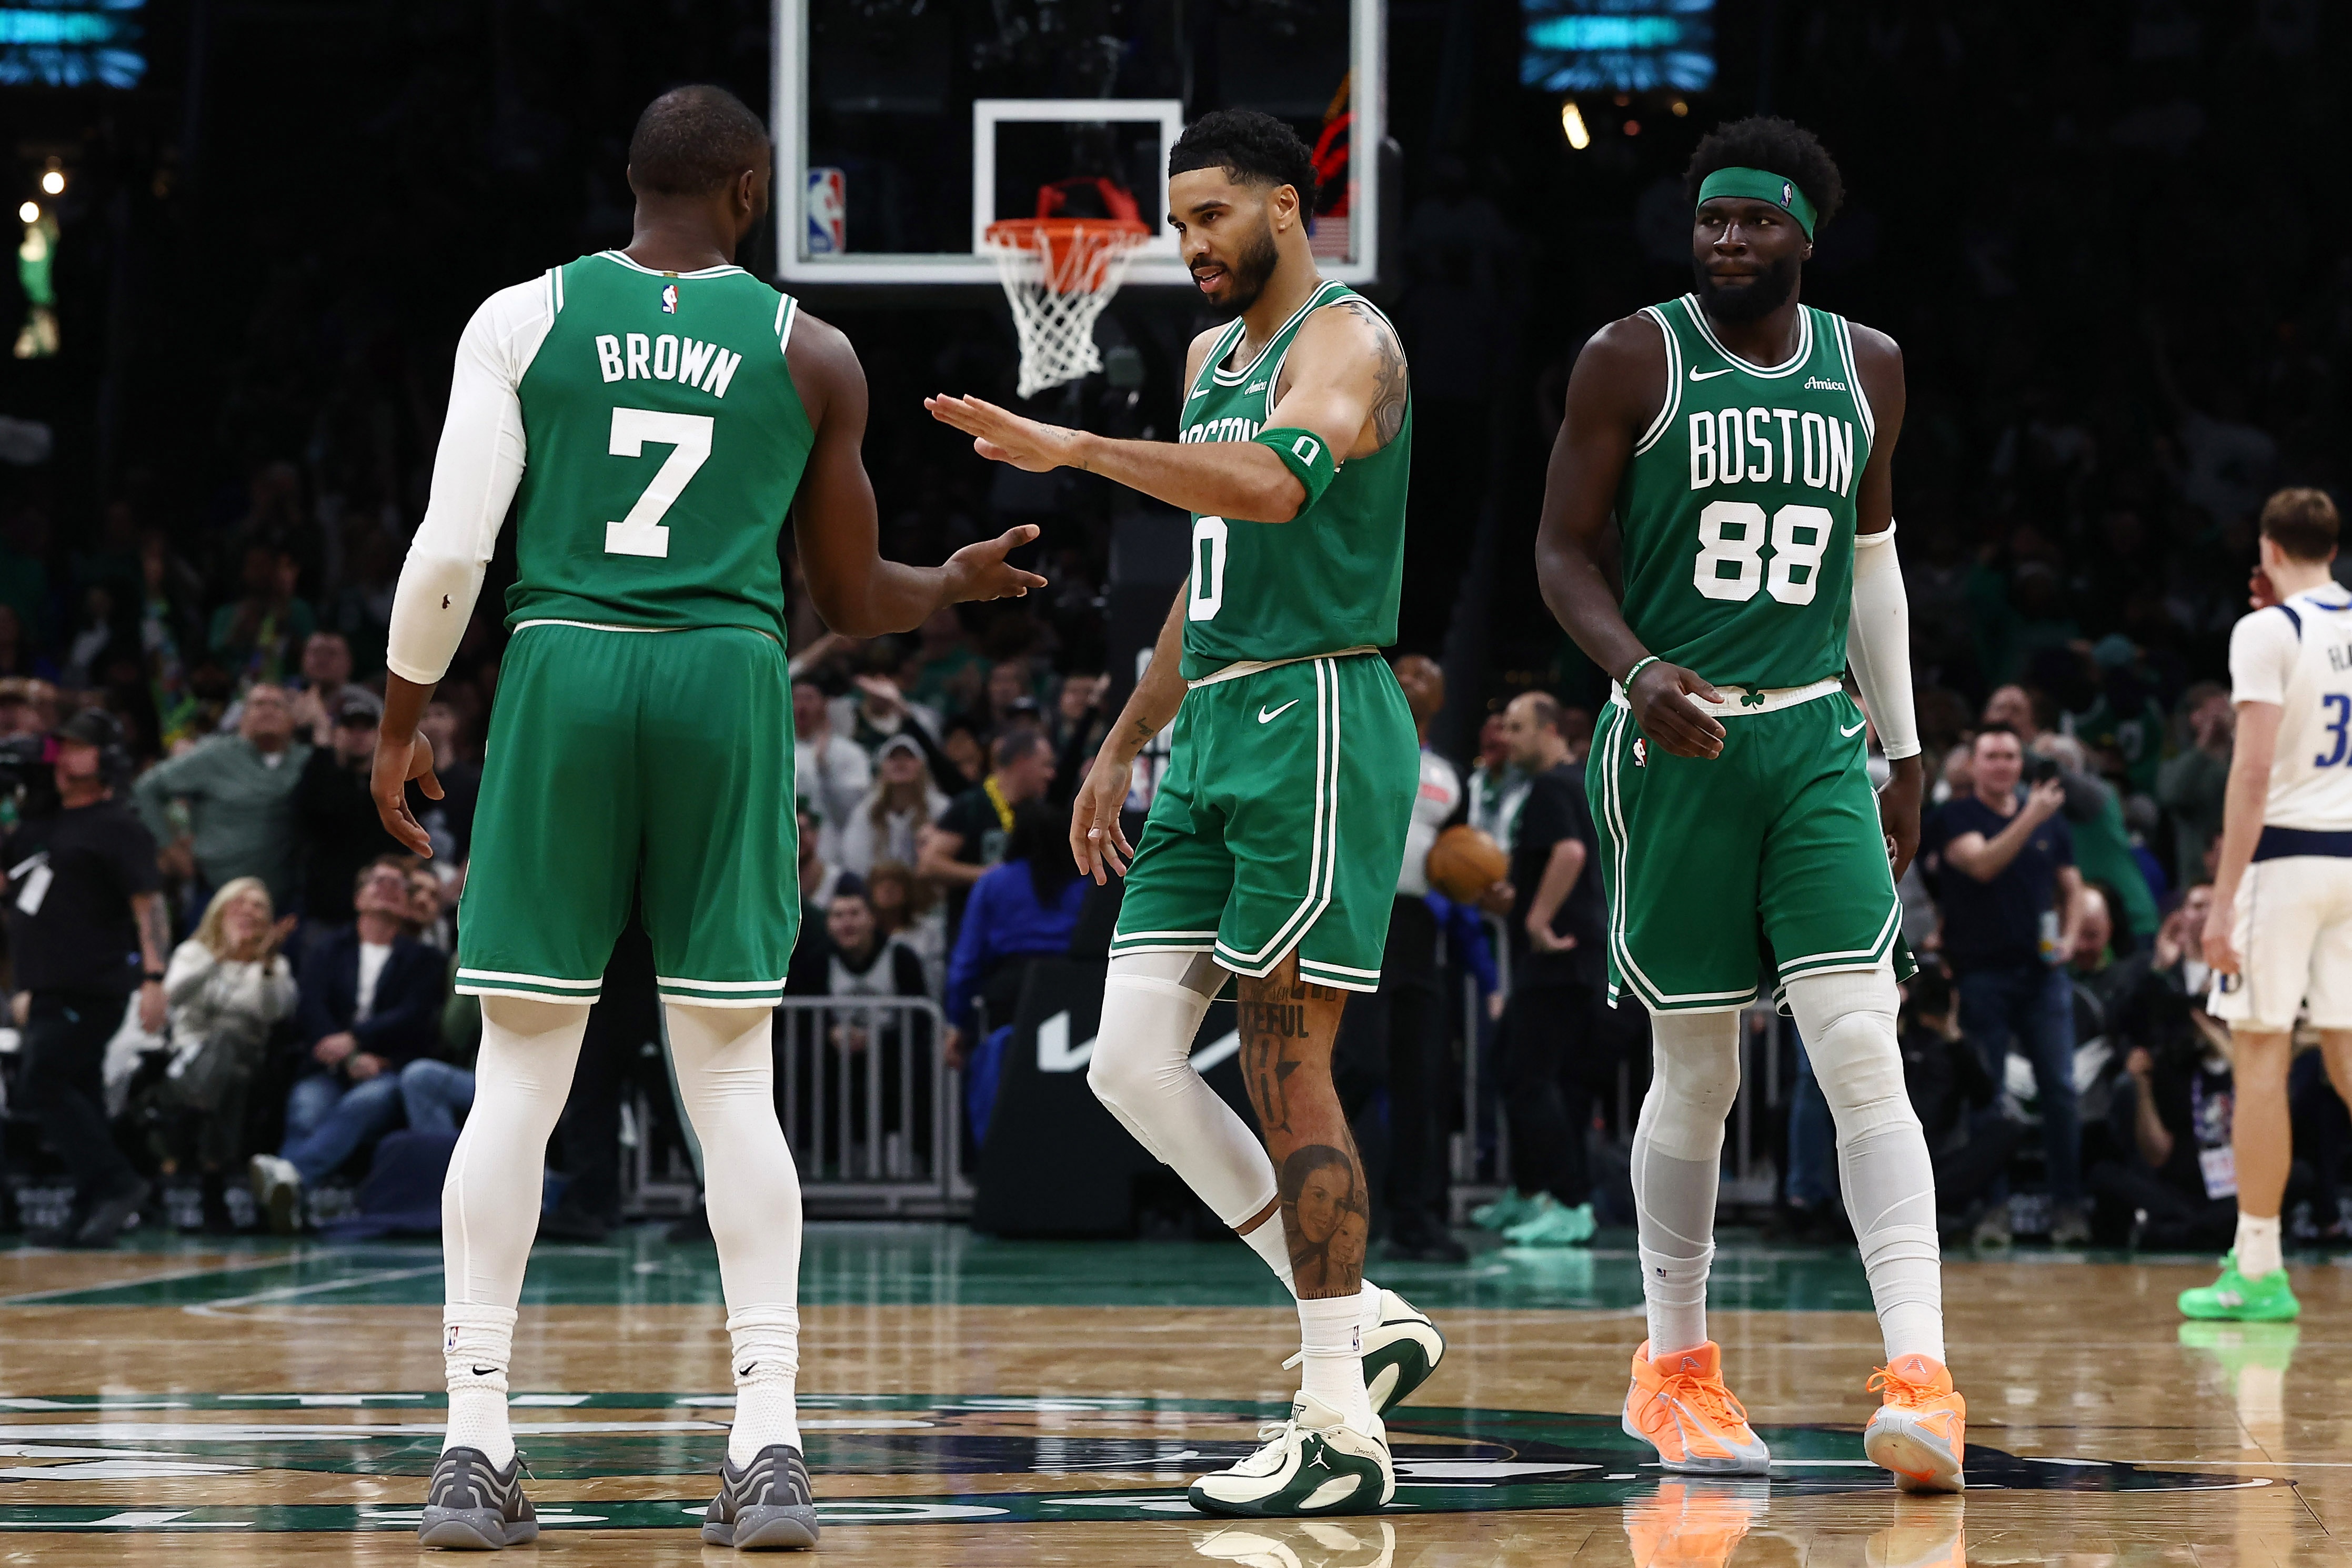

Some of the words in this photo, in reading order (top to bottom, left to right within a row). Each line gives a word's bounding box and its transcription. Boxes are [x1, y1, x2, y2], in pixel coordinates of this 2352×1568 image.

[595, 333, 742, 399] BROWN
[1244, 378, 1268, 395] Amica
[1804, 376, 1846, 391] Amica
[604, 407, 715, 558] 7
[1688, 407, 1853, 498] BOSTON
[1189, 516, 1228, 621] 0
[1693, 500, 1834, 606] 88
[2314, 693, 2352, 768] 3
